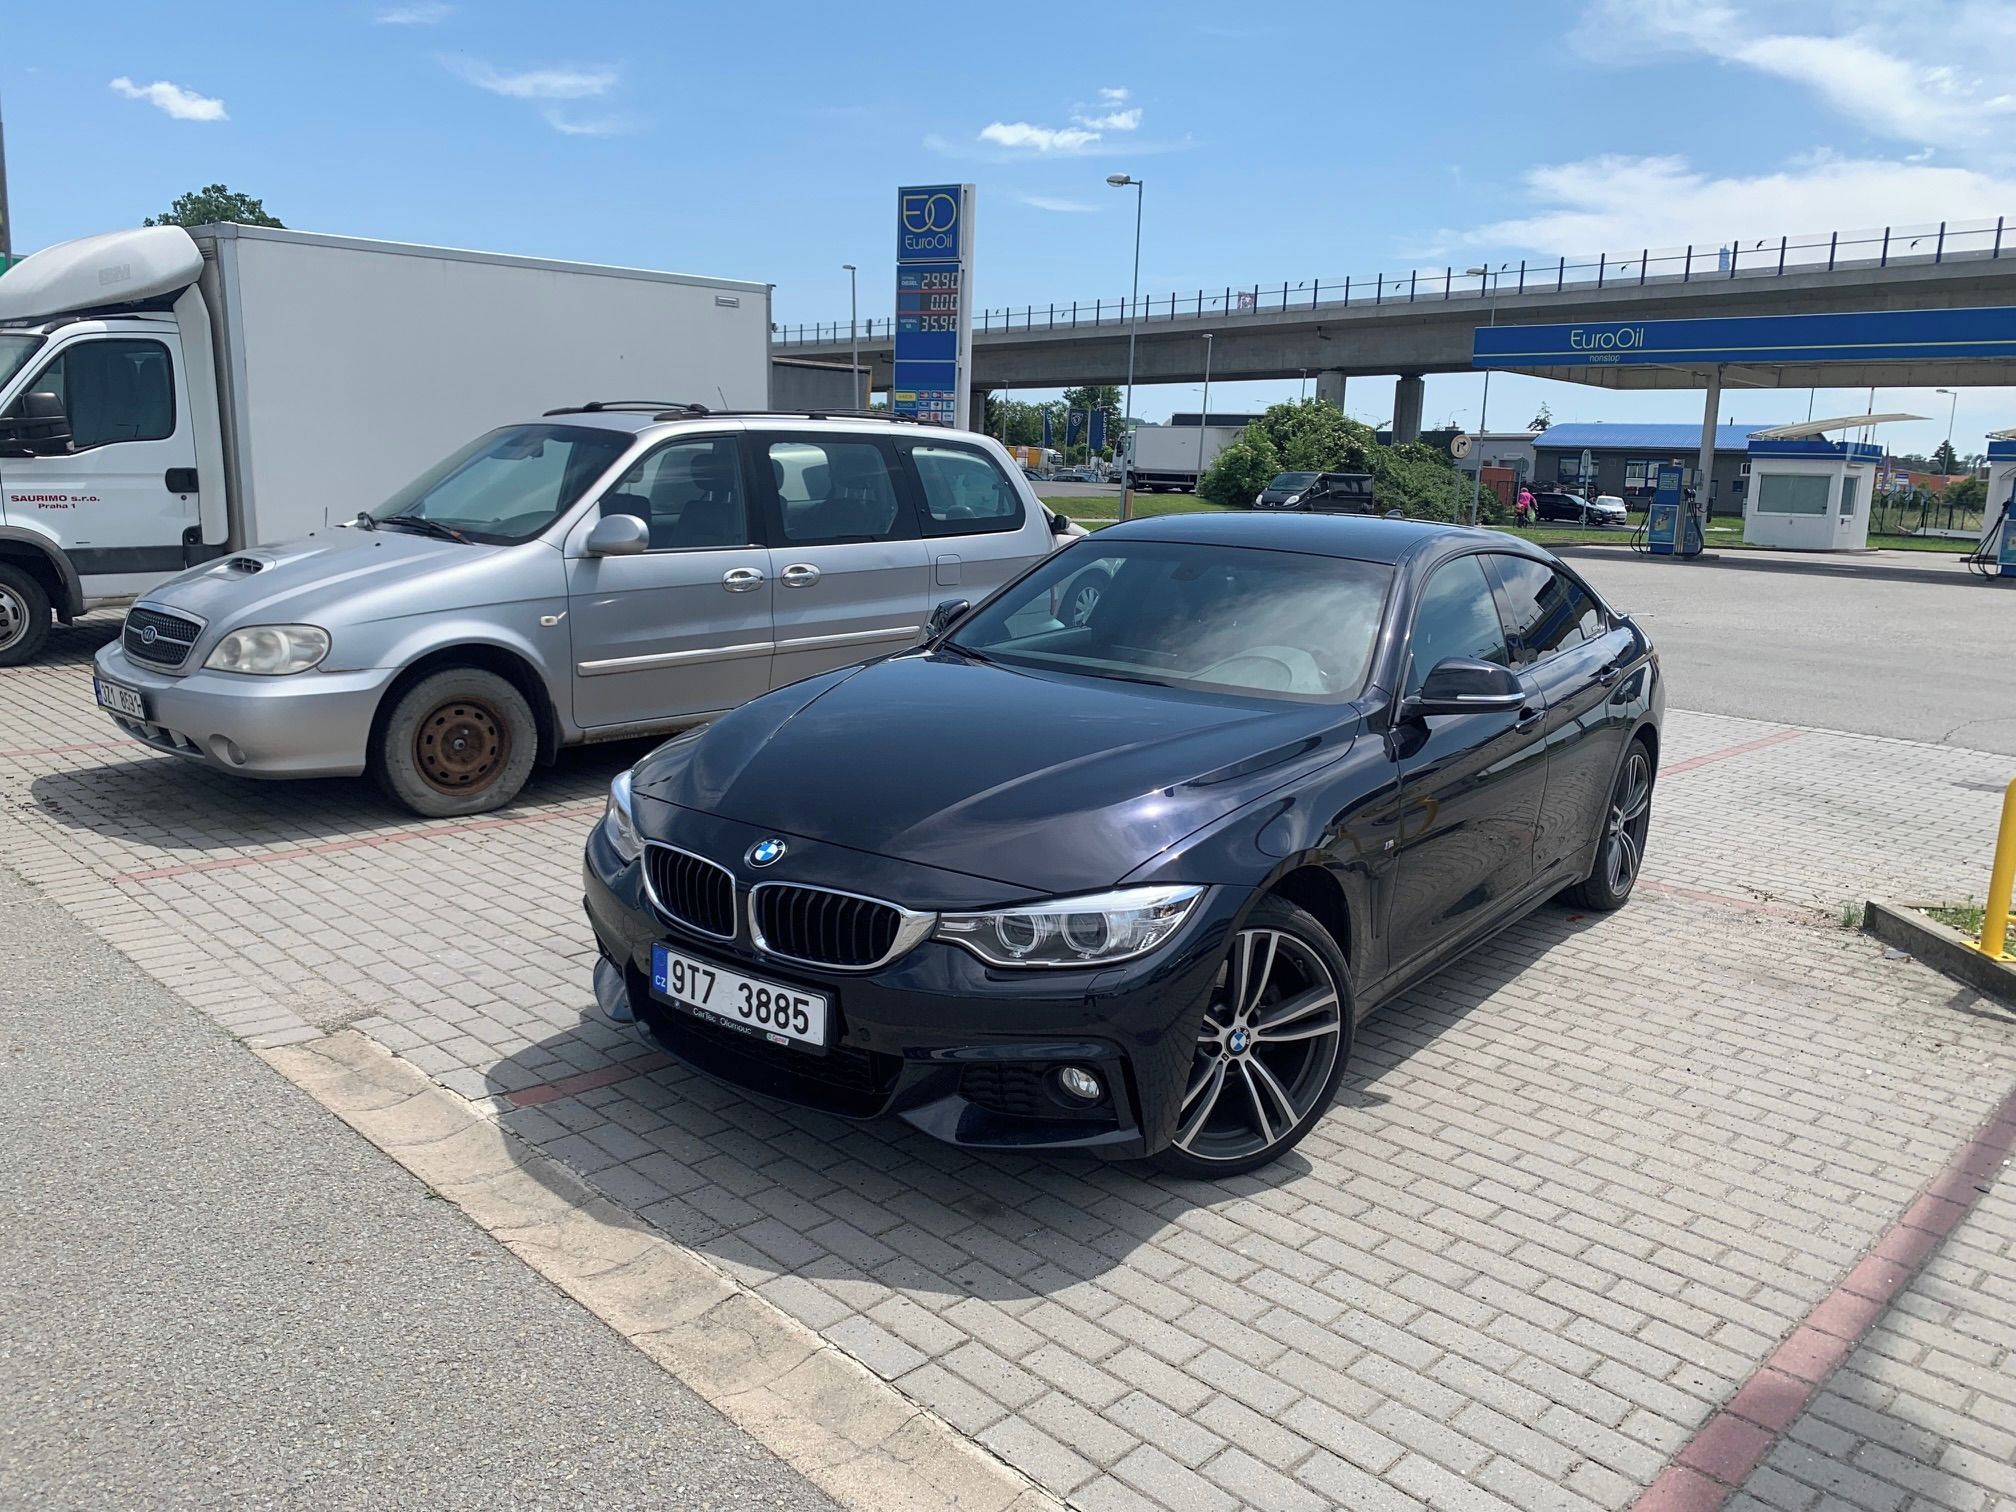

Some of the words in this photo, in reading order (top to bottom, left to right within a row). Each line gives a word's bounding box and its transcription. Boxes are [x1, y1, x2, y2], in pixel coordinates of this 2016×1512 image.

[905, 234, 952, 249] EuroOil
[1570, 328, 1644, 349] EuroOil
[1588, 354, 1621, 363] nonstop
[655, 975, 666, 988] CZ
[672, 959, 716, 1004] 9T7
[737, 982, 810, 1035] 3885
[693, 1007, 716, 1023] CarTec
